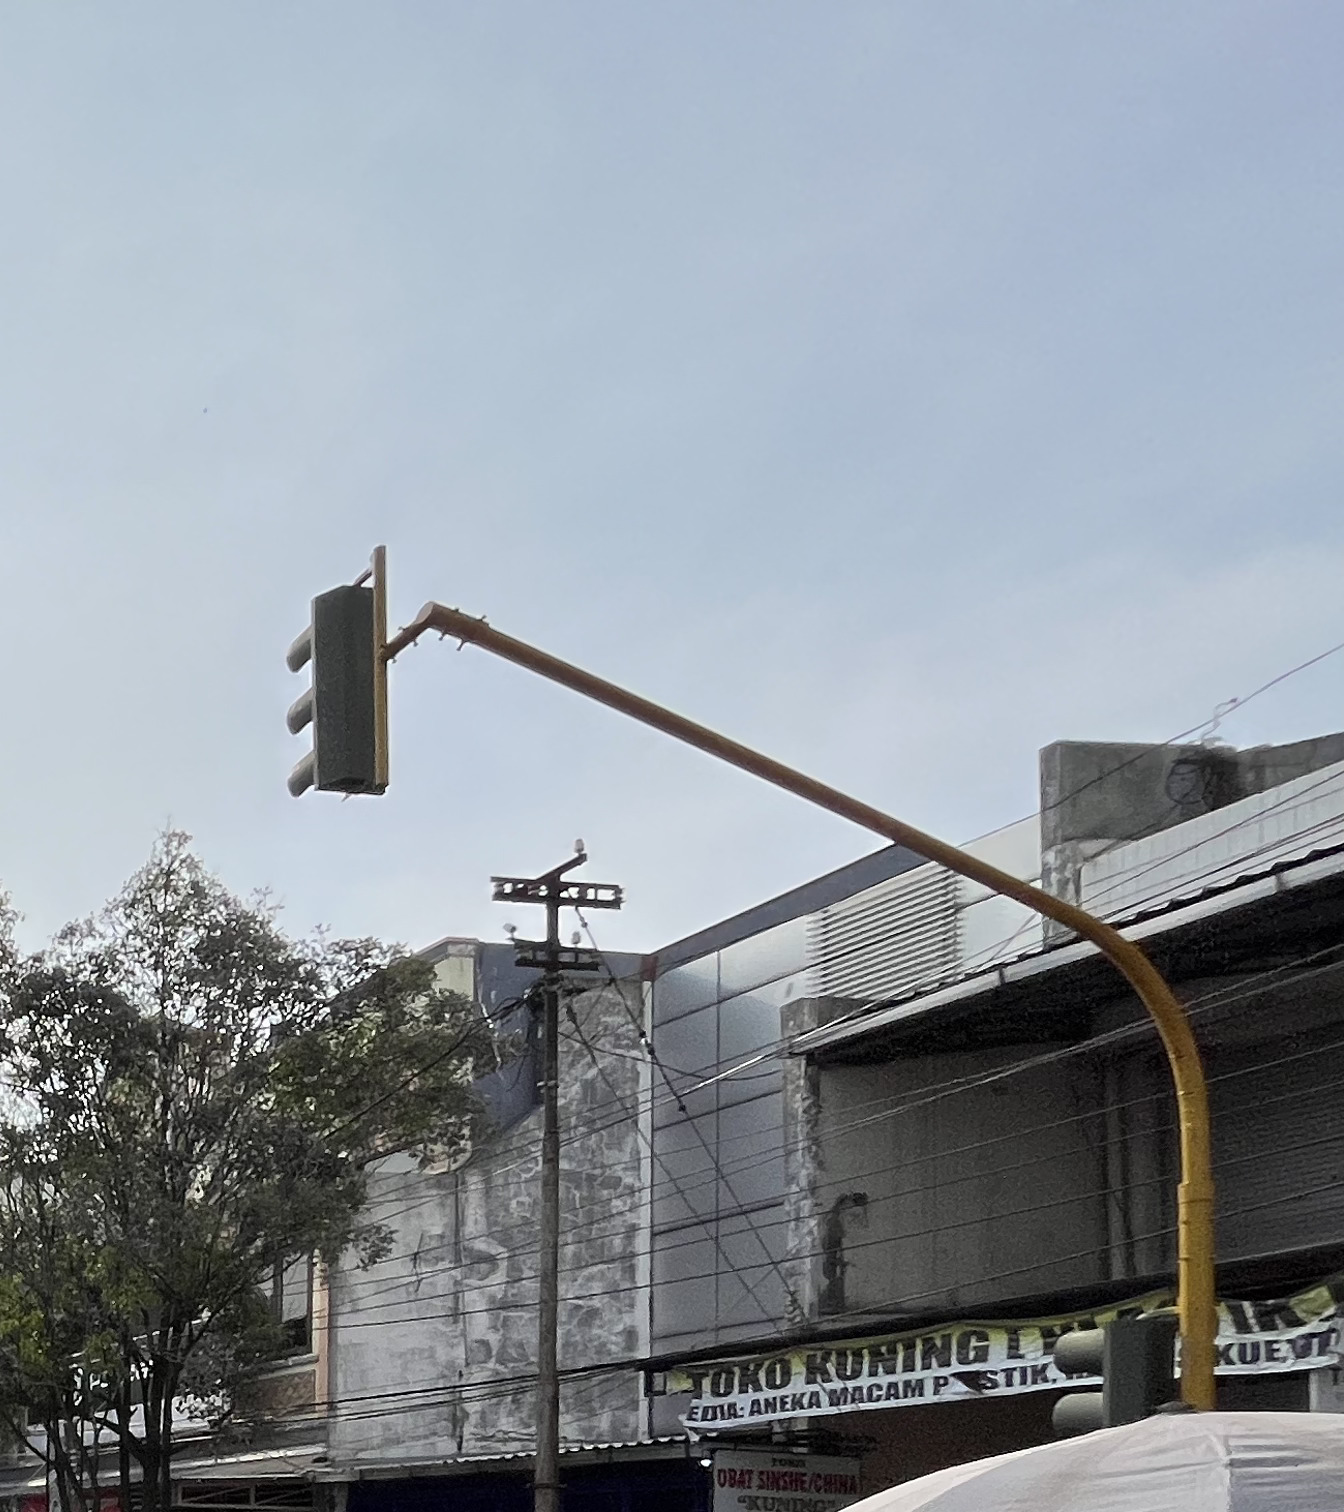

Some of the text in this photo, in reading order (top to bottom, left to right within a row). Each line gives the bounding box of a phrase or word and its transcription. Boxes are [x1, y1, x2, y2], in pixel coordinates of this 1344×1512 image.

[688, 1356, 792, 1400] TOKO
[805, 1329, 990, 1386] KUNING
[749, 1391, 822, 1417] ANEKA
[828, 1379, 925, 1408] MACAM
[933, 1363, 1057, 1397] PSTIK,
